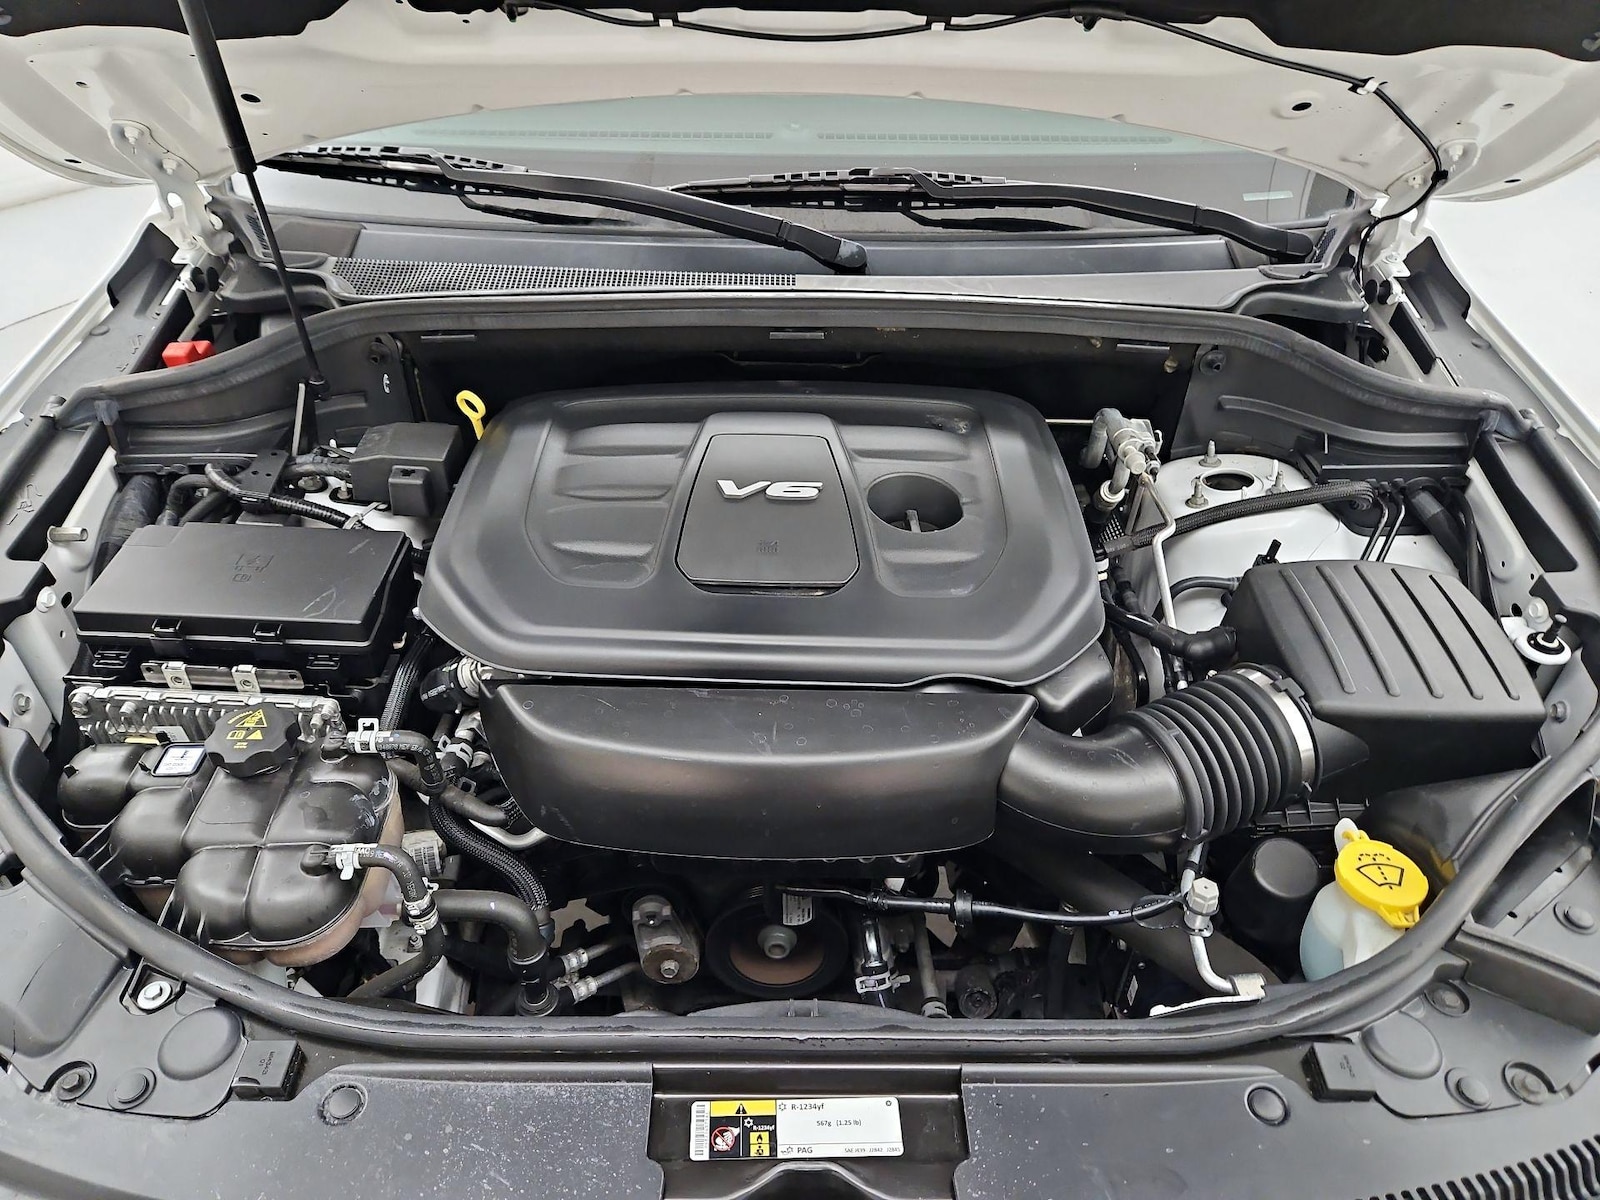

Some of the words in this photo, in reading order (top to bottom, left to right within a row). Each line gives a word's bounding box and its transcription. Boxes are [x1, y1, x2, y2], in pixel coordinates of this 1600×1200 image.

[716, 479, 824, 501] V6
[791, 1103, 825, 1111] R-1234yf
[836, 1119, 852, 1127] (1.25
[853, 1119, 862, 1127] lb)
